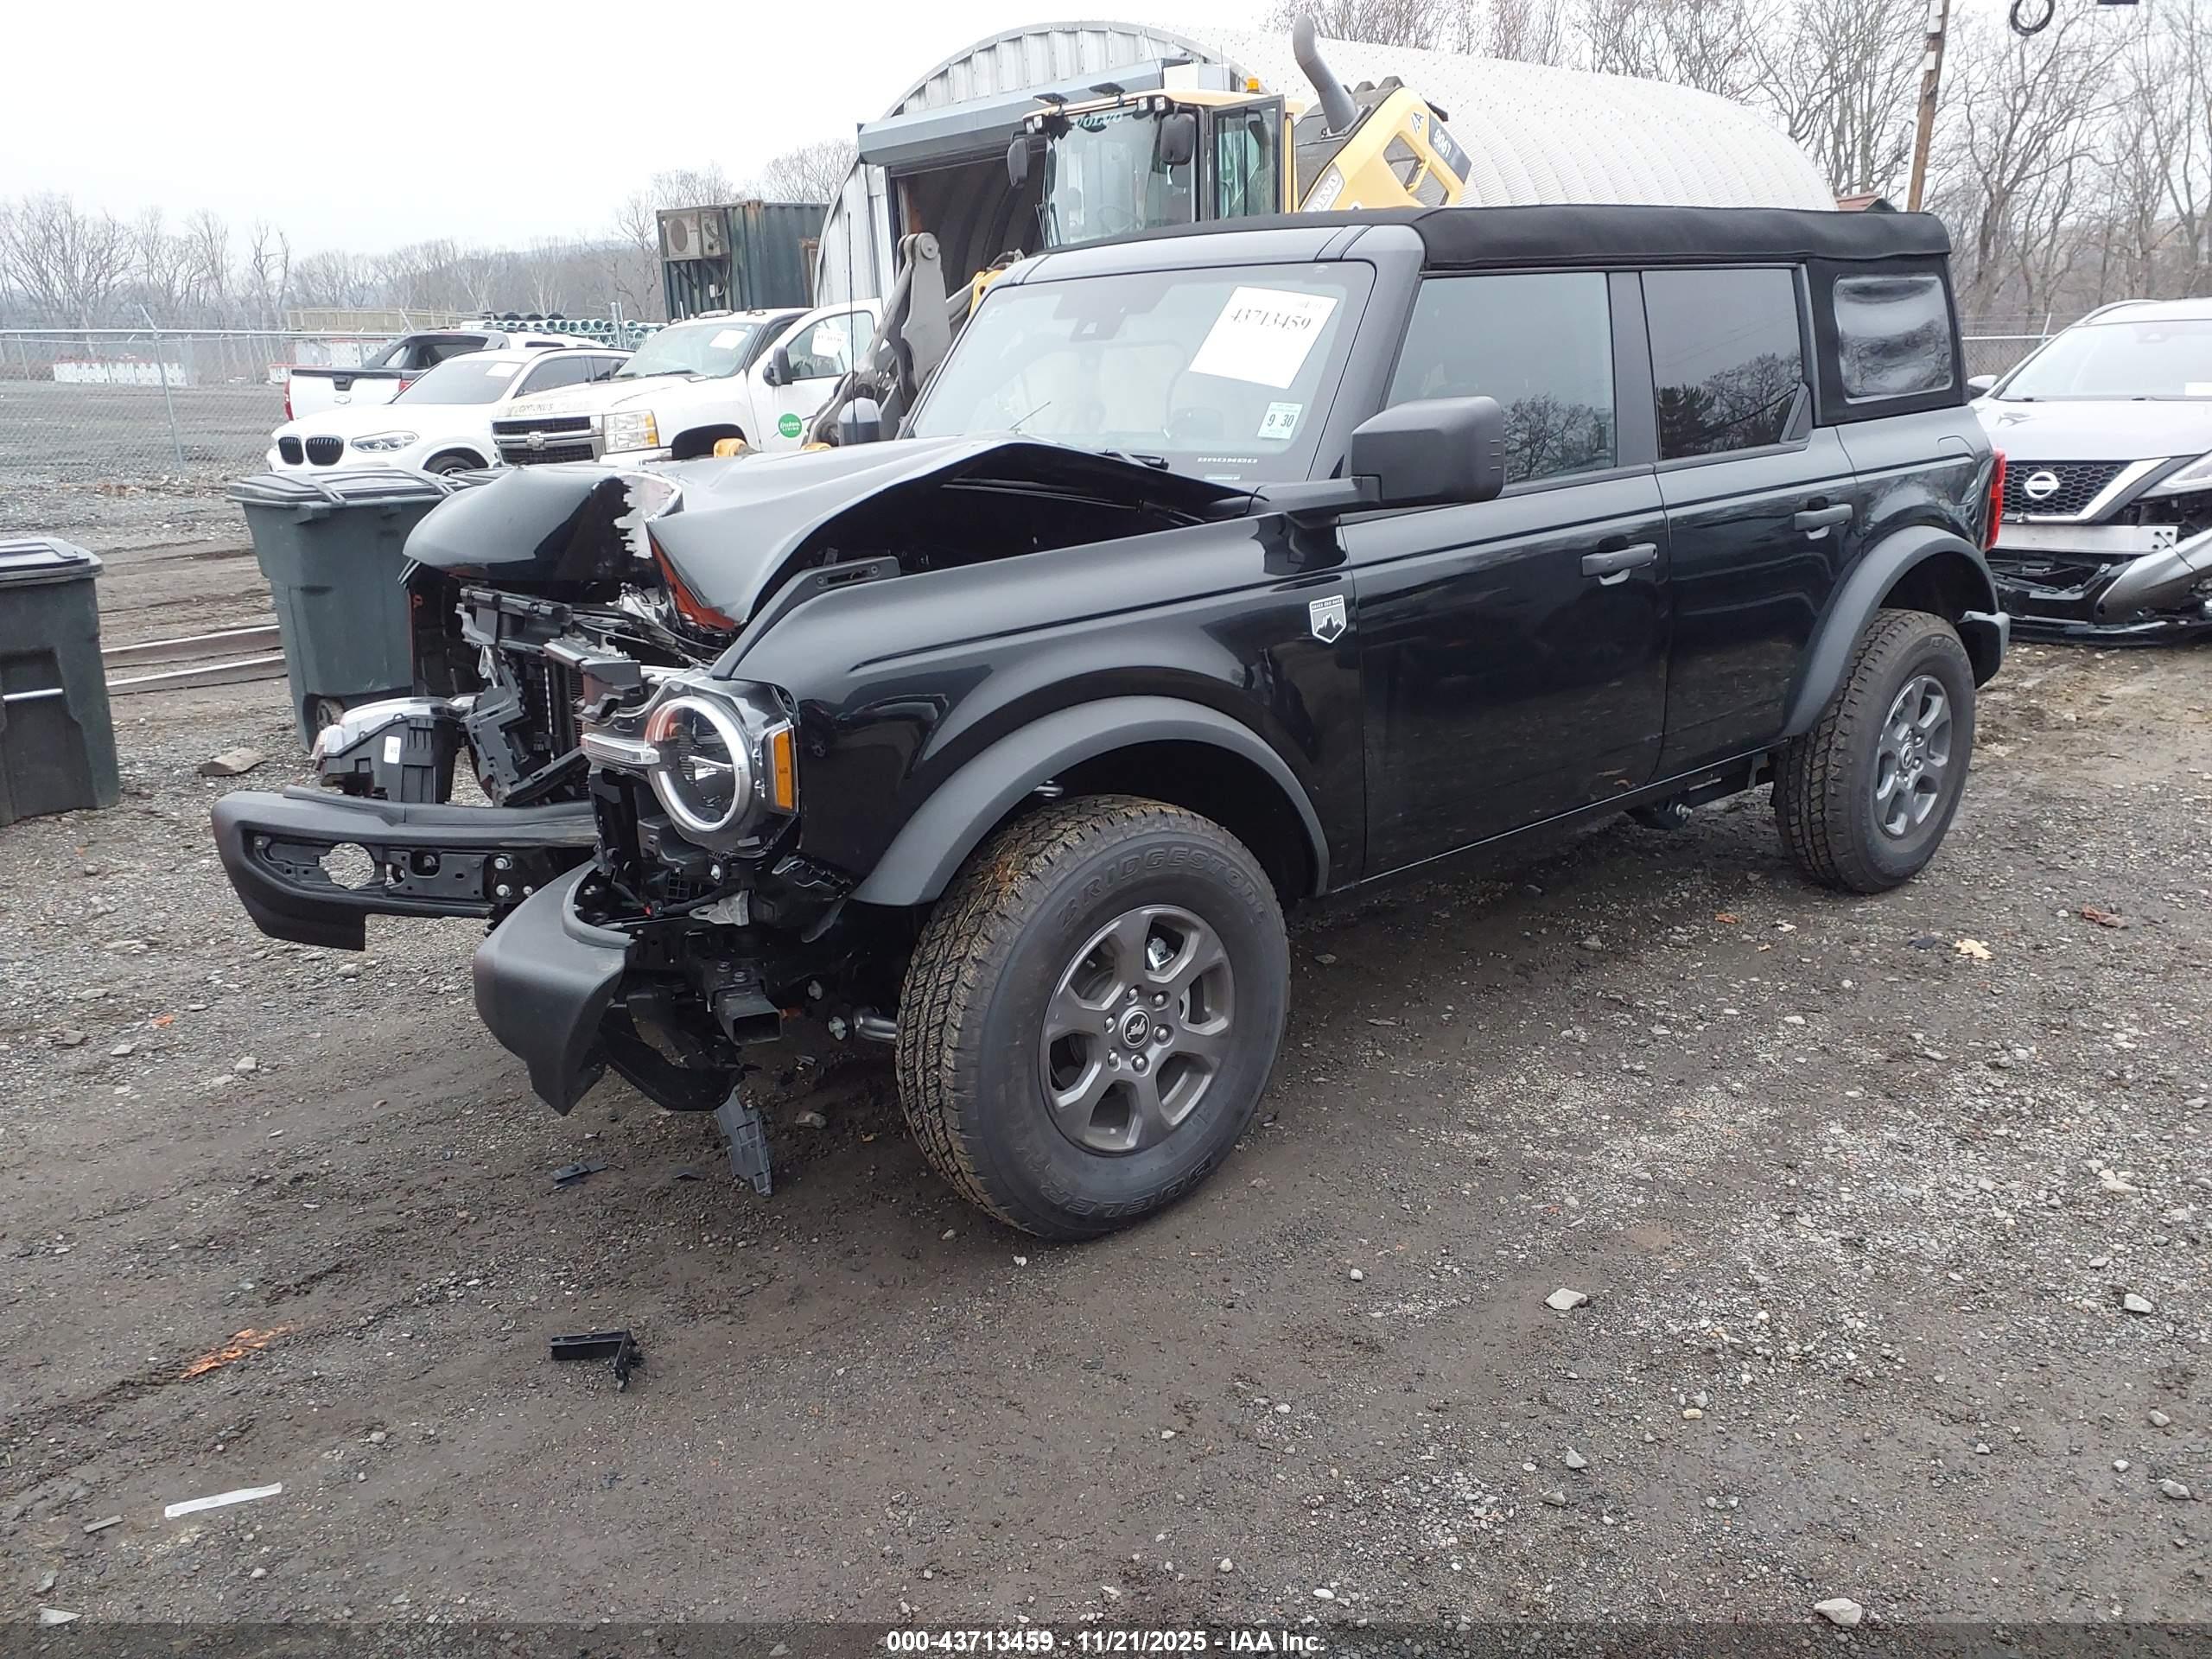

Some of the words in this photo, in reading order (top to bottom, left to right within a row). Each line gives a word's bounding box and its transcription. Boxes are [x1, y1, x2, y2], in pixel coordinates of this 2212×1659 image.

[1073, 112, 1122, 128] VOLVO
[1230, 308, 1313, 330] 43713459
[1280, 413, 1295, 428] 30
